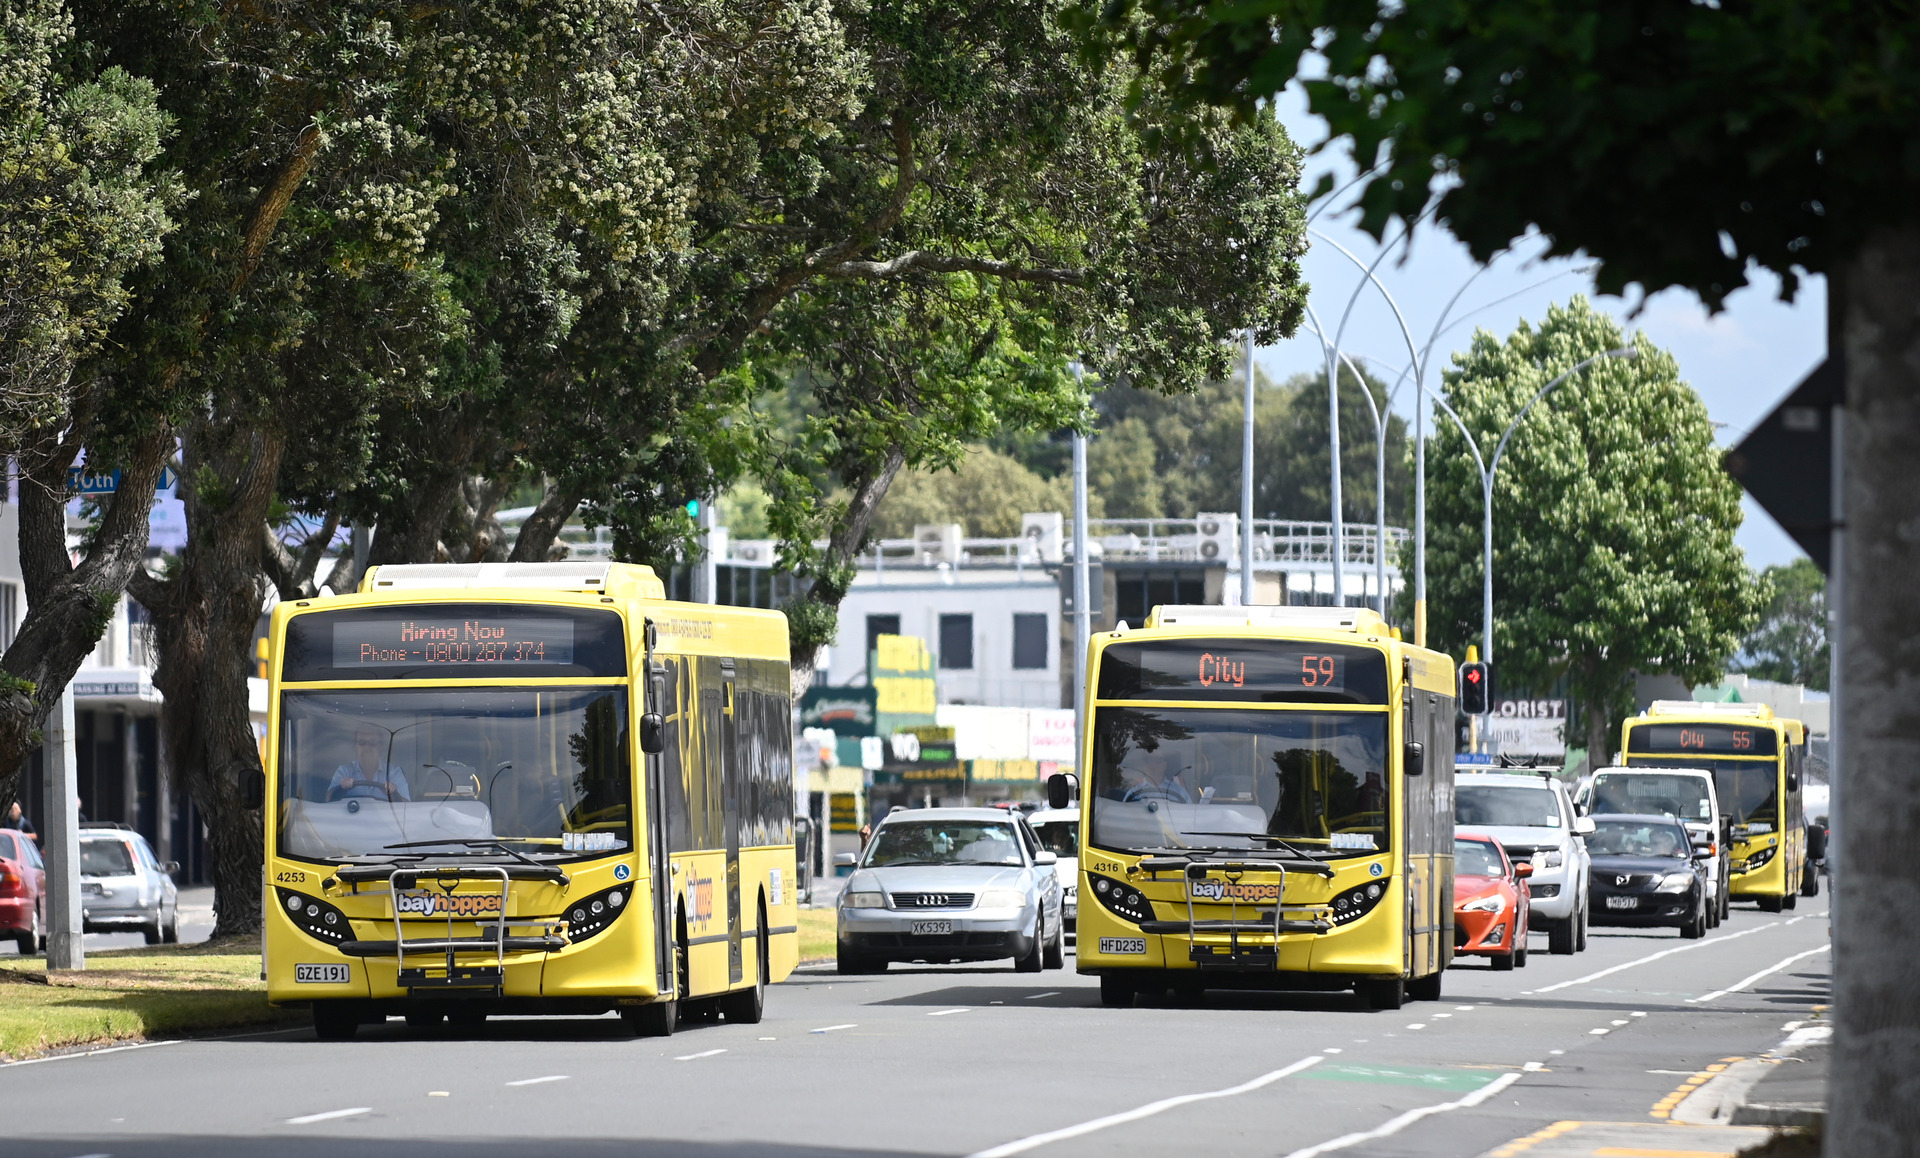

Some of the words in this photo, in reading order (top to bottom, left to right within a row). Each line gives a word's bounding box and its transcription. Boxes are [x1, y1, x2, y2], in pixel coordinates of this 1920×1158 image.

[401, 621, 458, 641] Hiring
[464, 621, 505, 640] Now
[360, 643, 406, 663] Phone
[425, 642, 471, 662] 0800
[475, 641, 508, 662] 287
[512, 641, 545, 661] 374
[1199, 652, 1245, 688] City
[1301, 655, 1335, 687] 59
[1680, 729, 1704, 748] City
[1732, 730, 1751, 749] 55
[276, 871, 306, 884] 4253
[1093, 862, 1119, 873] 4316
[1192, 880, 1284, 902] bayhopper
[397, 893, 507, 917] bayhopper
[912, 921, 952, 934] XK5393
[1100, 939, 1145, 953] HFD235
[296, 965, 347, 982] GZE191
